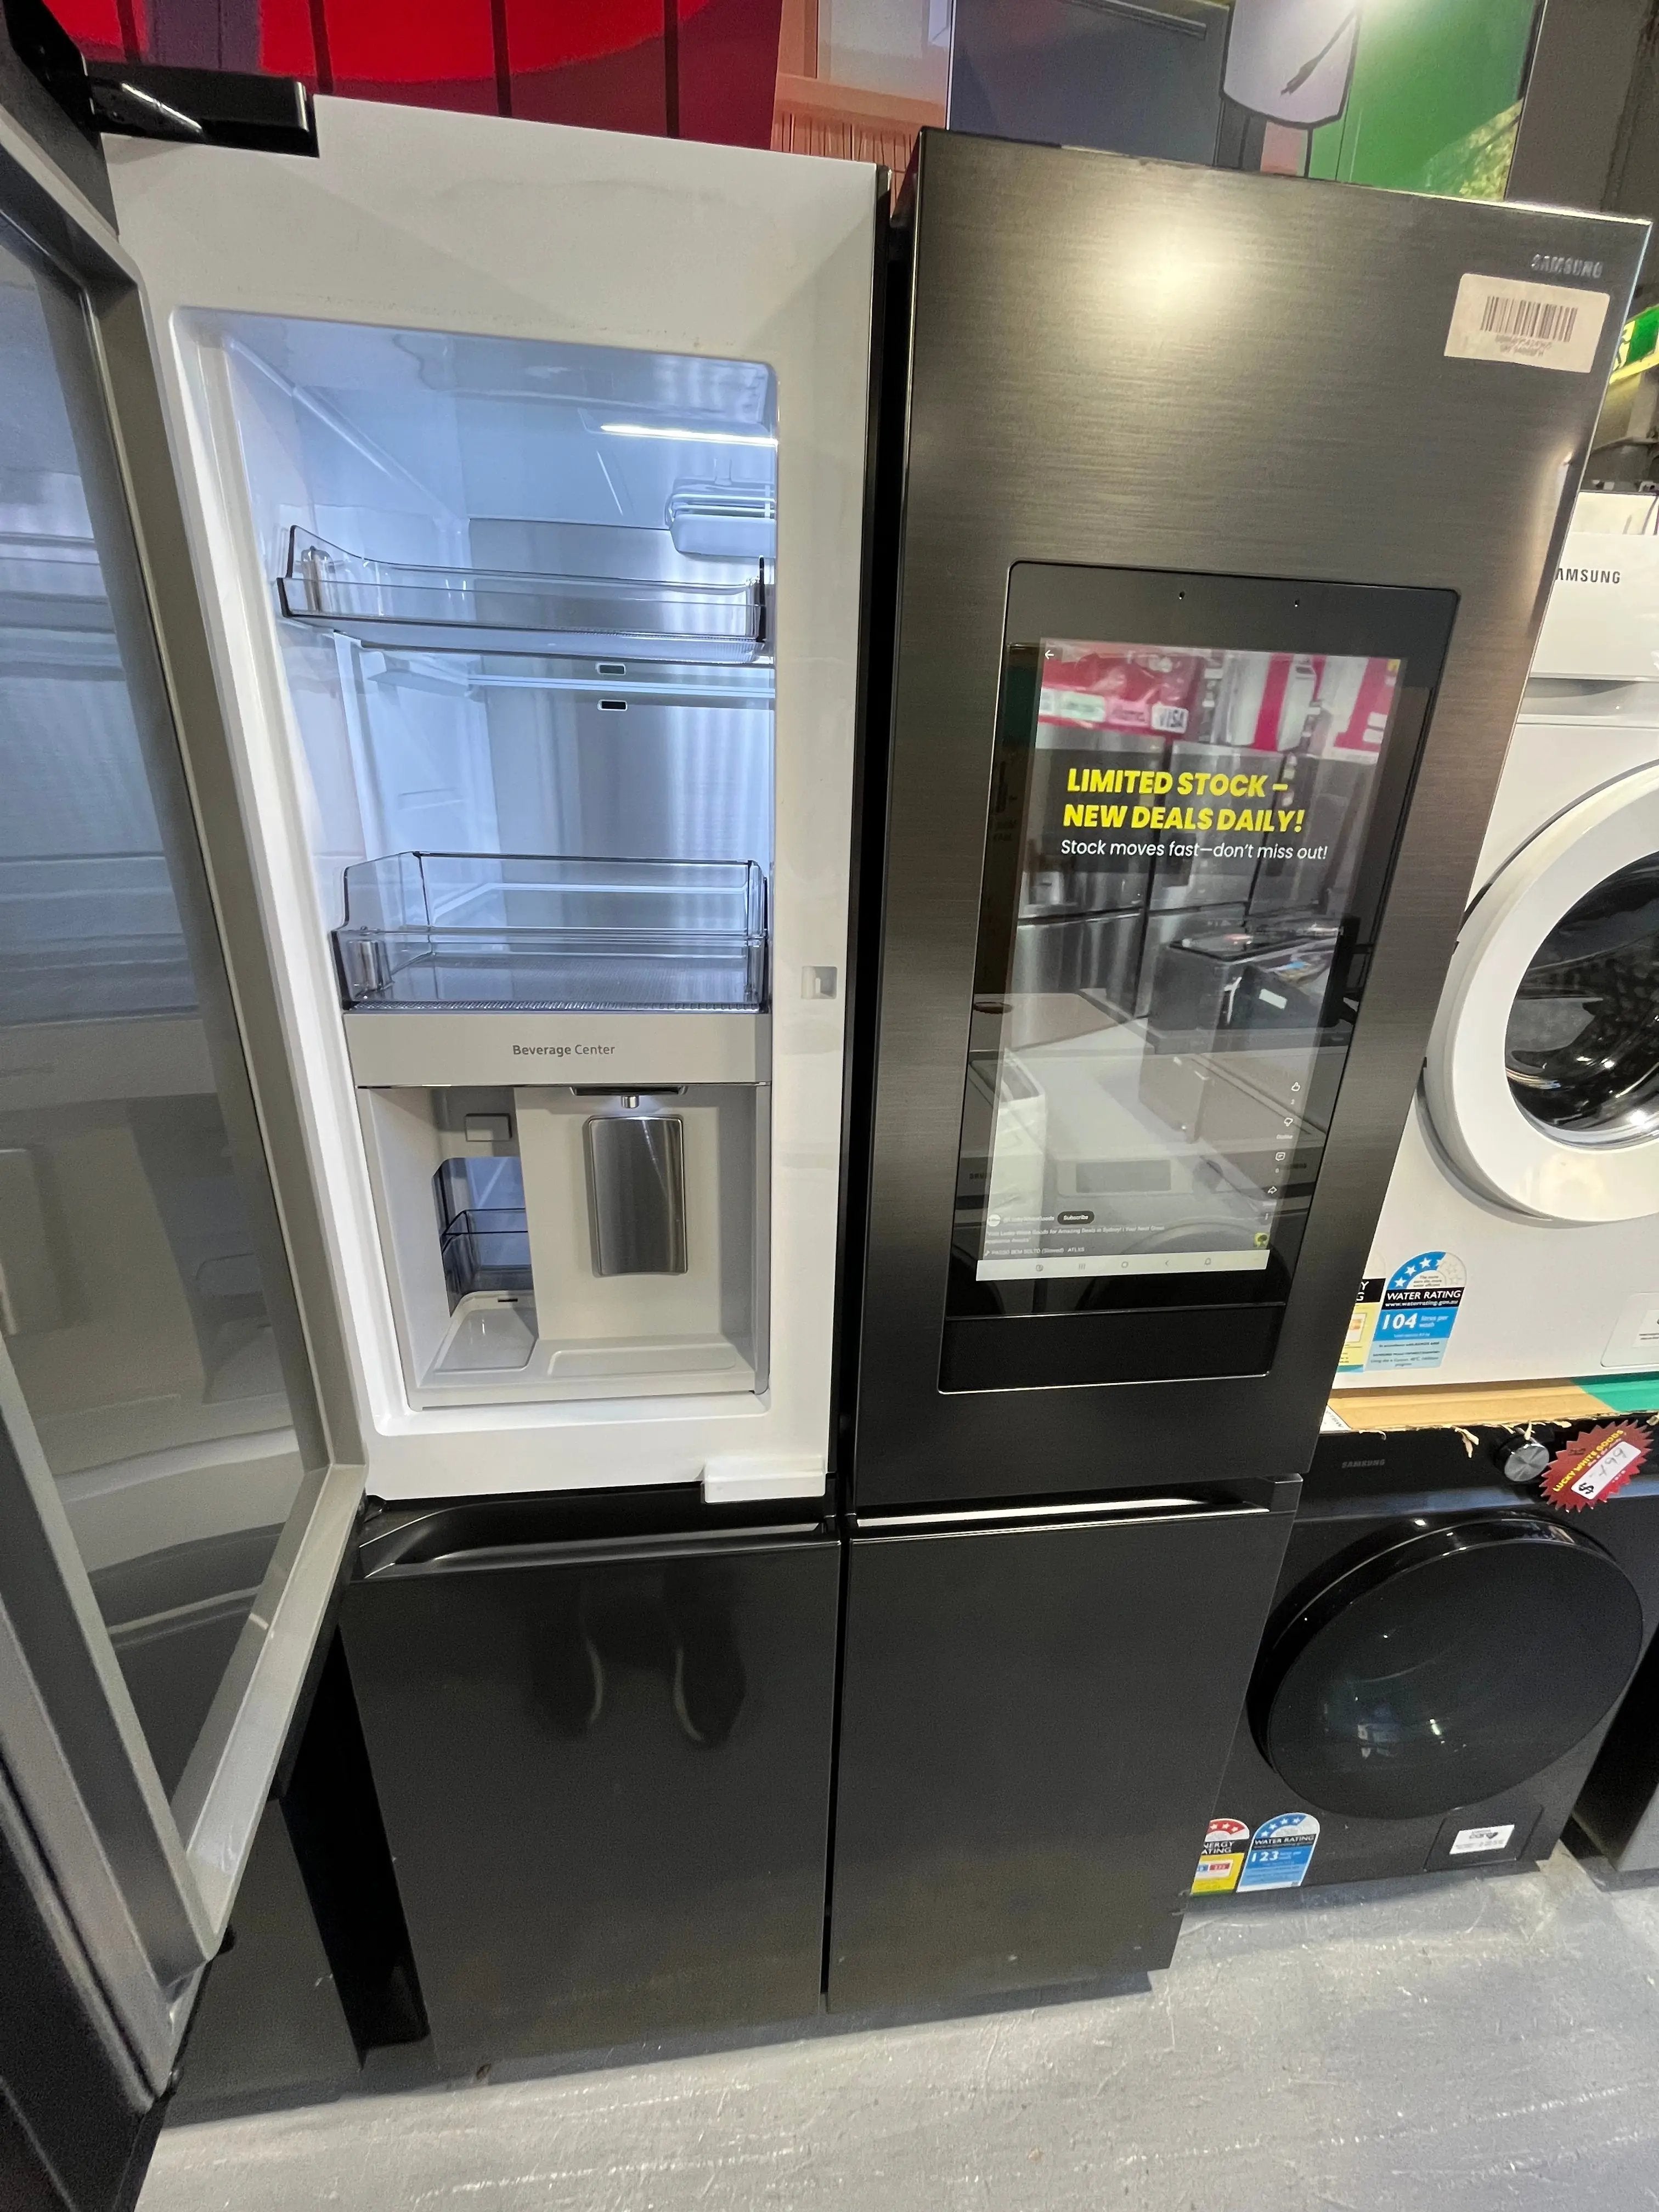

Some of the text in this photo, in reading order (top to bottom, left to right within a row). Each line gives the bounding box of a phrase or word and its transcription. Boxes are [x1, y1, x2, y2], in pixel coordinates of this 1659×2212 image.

[1531, 254, 1603, 279] SAMSUNG
[1555, 568, 1621, 584] AMSUNG
[1067, 769, 1173, 794] LIMITED
[1177, 773, 1269, 797] STOCK
[1063, 804, 1305, 833] NEW DEALS DAILY!
[1061, 839, 1105, 855] Stock
[1110, 844, 1165, 856] moves
[1259, 845, 1293, 859] miss
[1297, 846, 1328, 860] out!
[512, 1045, 615, 1057] Beverage Center
[1387, 1290, 1461, 1300] WATER RATING
[1382, 1312, 1418, 1330] 104
[1553, 1470, 1576, 1492] LUCKY
[1573, 1451, 1598, 1472] WHITE
[1596, 1430, 1624, 1451] GOODS
[1251, 1850, 1279, 1862] 123
